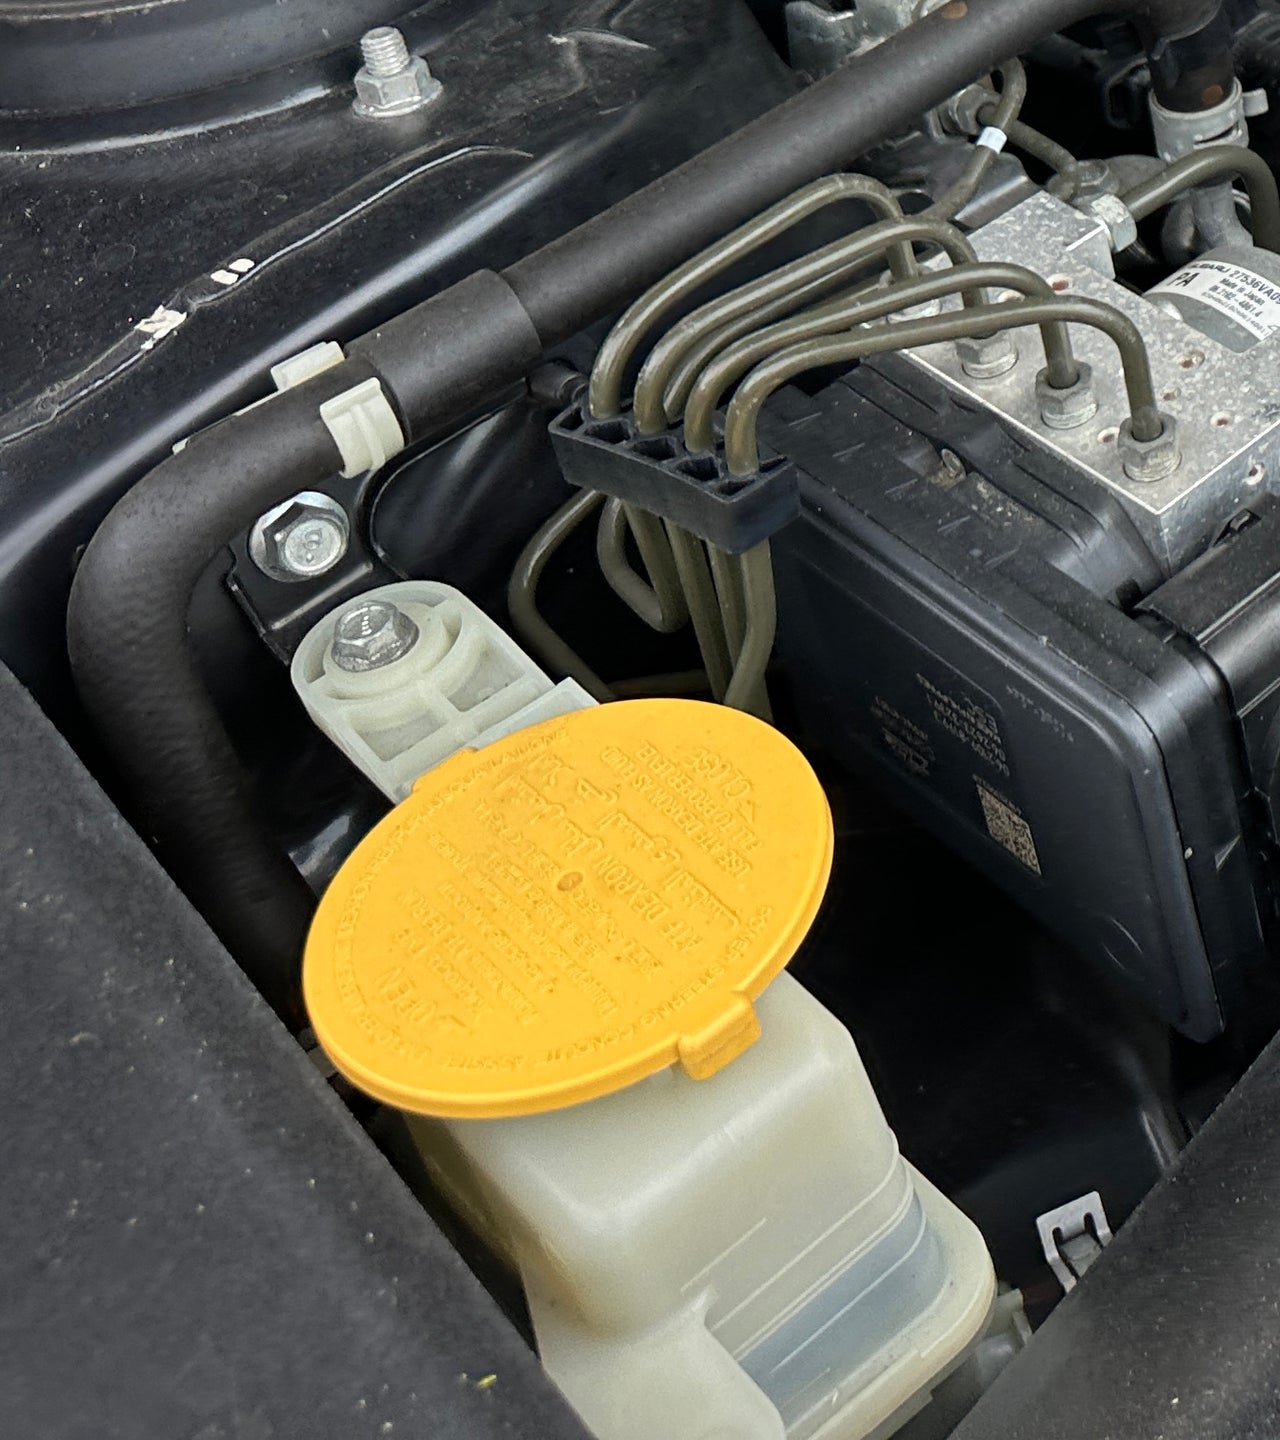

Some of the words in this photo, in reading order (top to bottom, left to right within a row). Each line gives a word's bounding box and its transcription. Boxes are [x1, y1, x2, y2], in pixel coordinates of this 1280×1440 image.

[680, 742, 757, 805] CLOSE
[587, 852, 674, 924] DEXRON
[369, 962, 441, 1028] OPEN
